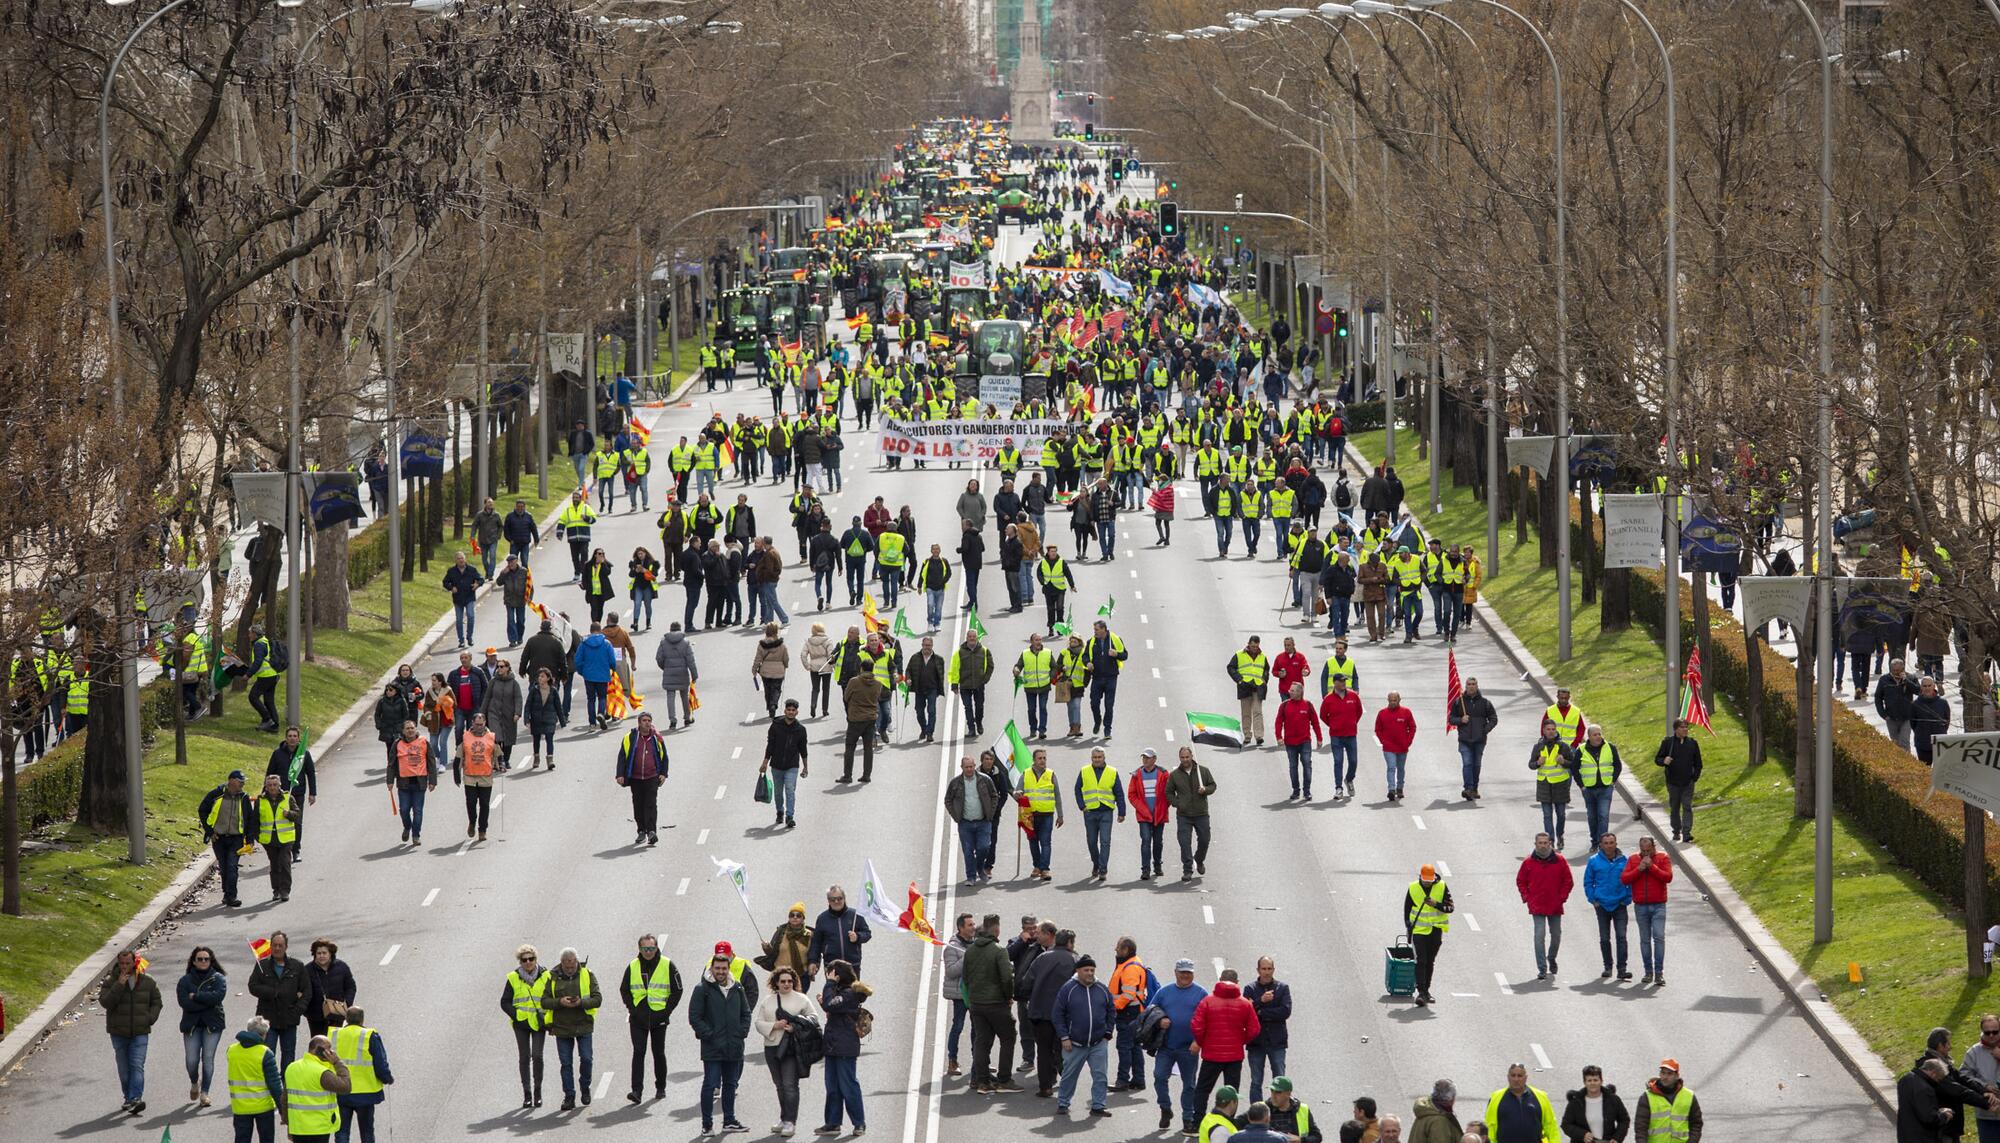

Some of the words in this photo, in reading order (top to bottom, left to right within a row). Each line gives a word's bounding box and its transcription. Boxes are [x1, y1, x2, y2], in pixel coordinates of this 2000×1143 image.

[951, 275, 970, 287] NO
[566, 354, 580, 365] RA
[954, 425, 960, 435] Y
[963, 424, 1015, 435] GANADEROS
[1016, 424, 1028, 435] DE
[1030, 424, 1040, 435] LA
[882, 436, 910, 453] NO
[913, 441, 926, 456] A
[933, 442, 953, 457] LA
[1608, 526, 1659, 536] QUINTANILLA
[1937, 738, 2000, 757] MA
[1954, 786, 1987, 804] MADRID
